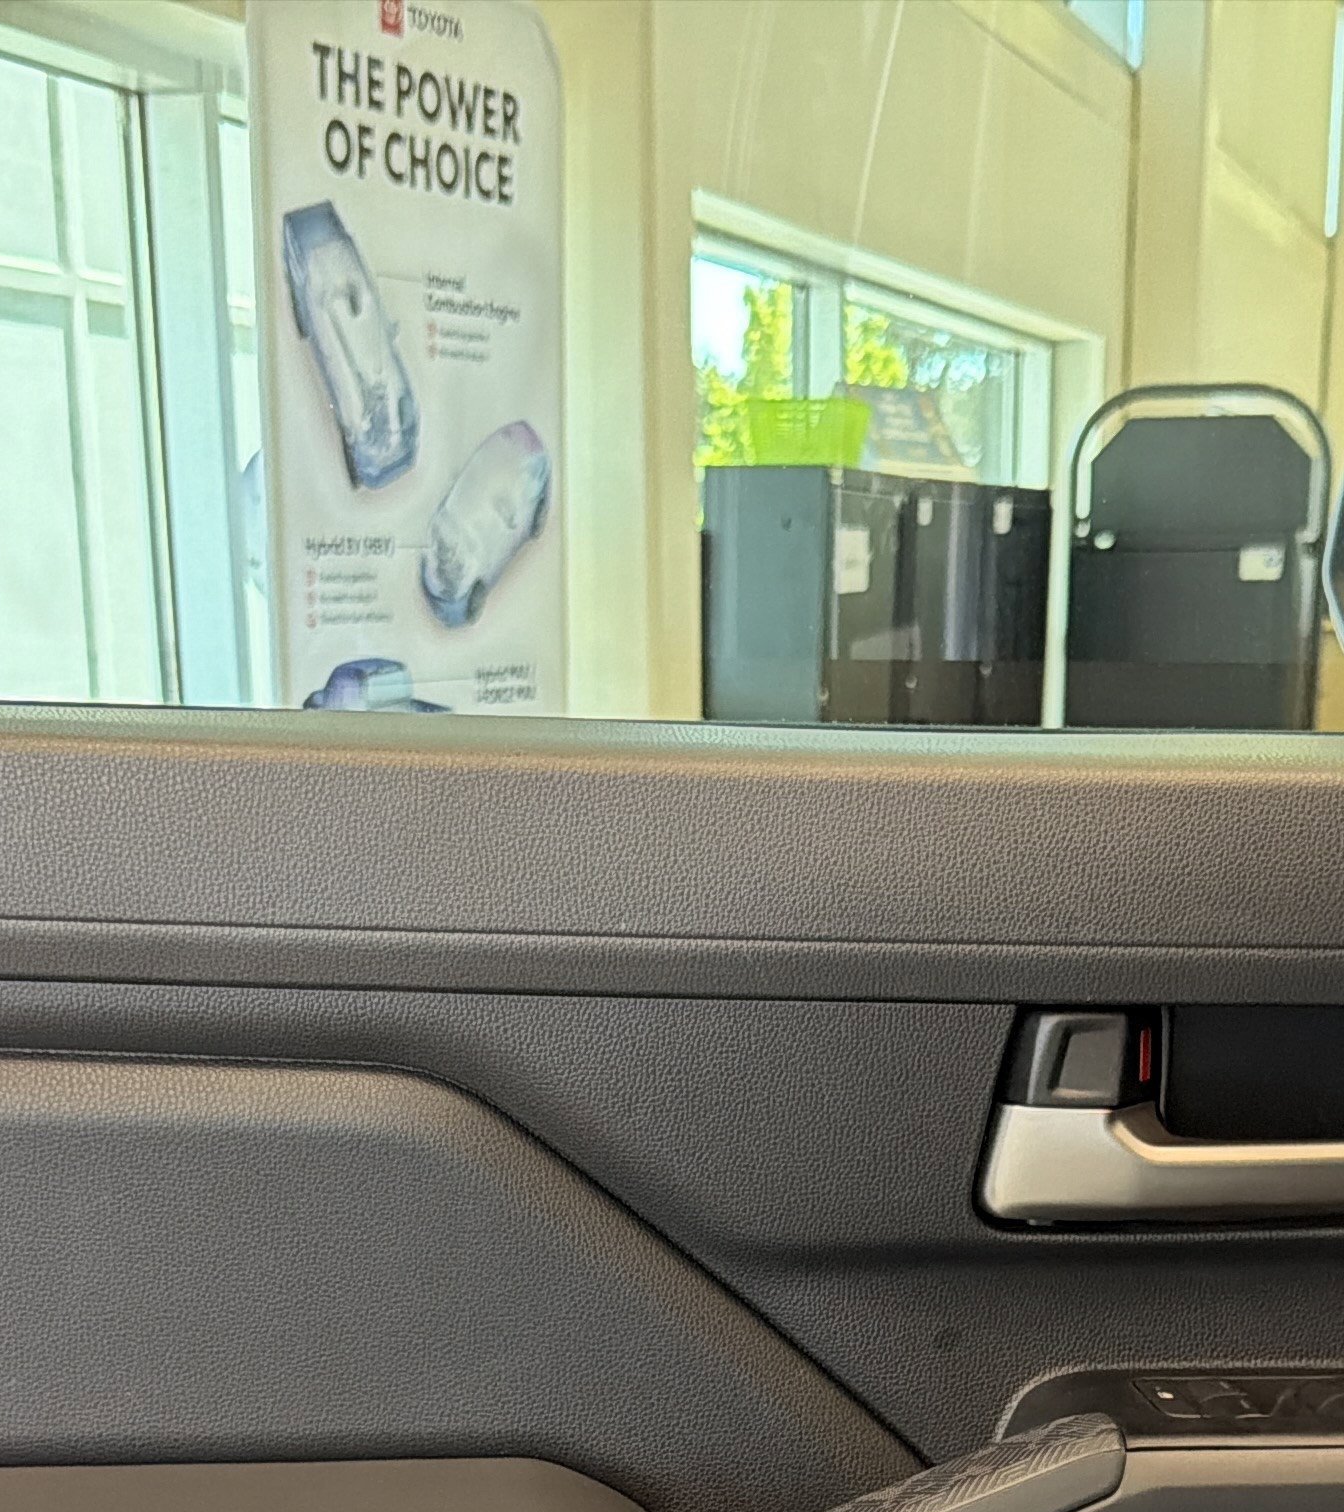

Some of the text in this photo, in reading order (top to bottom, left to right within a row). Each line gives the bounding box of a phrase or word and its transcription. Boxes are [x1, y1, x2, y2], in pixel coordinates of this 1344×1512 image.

[407, 5, 464, 41] TOYOTA
[312, 41, 520, 146] THE POWER
[325, 118, 514, 204] OF CHOICE
